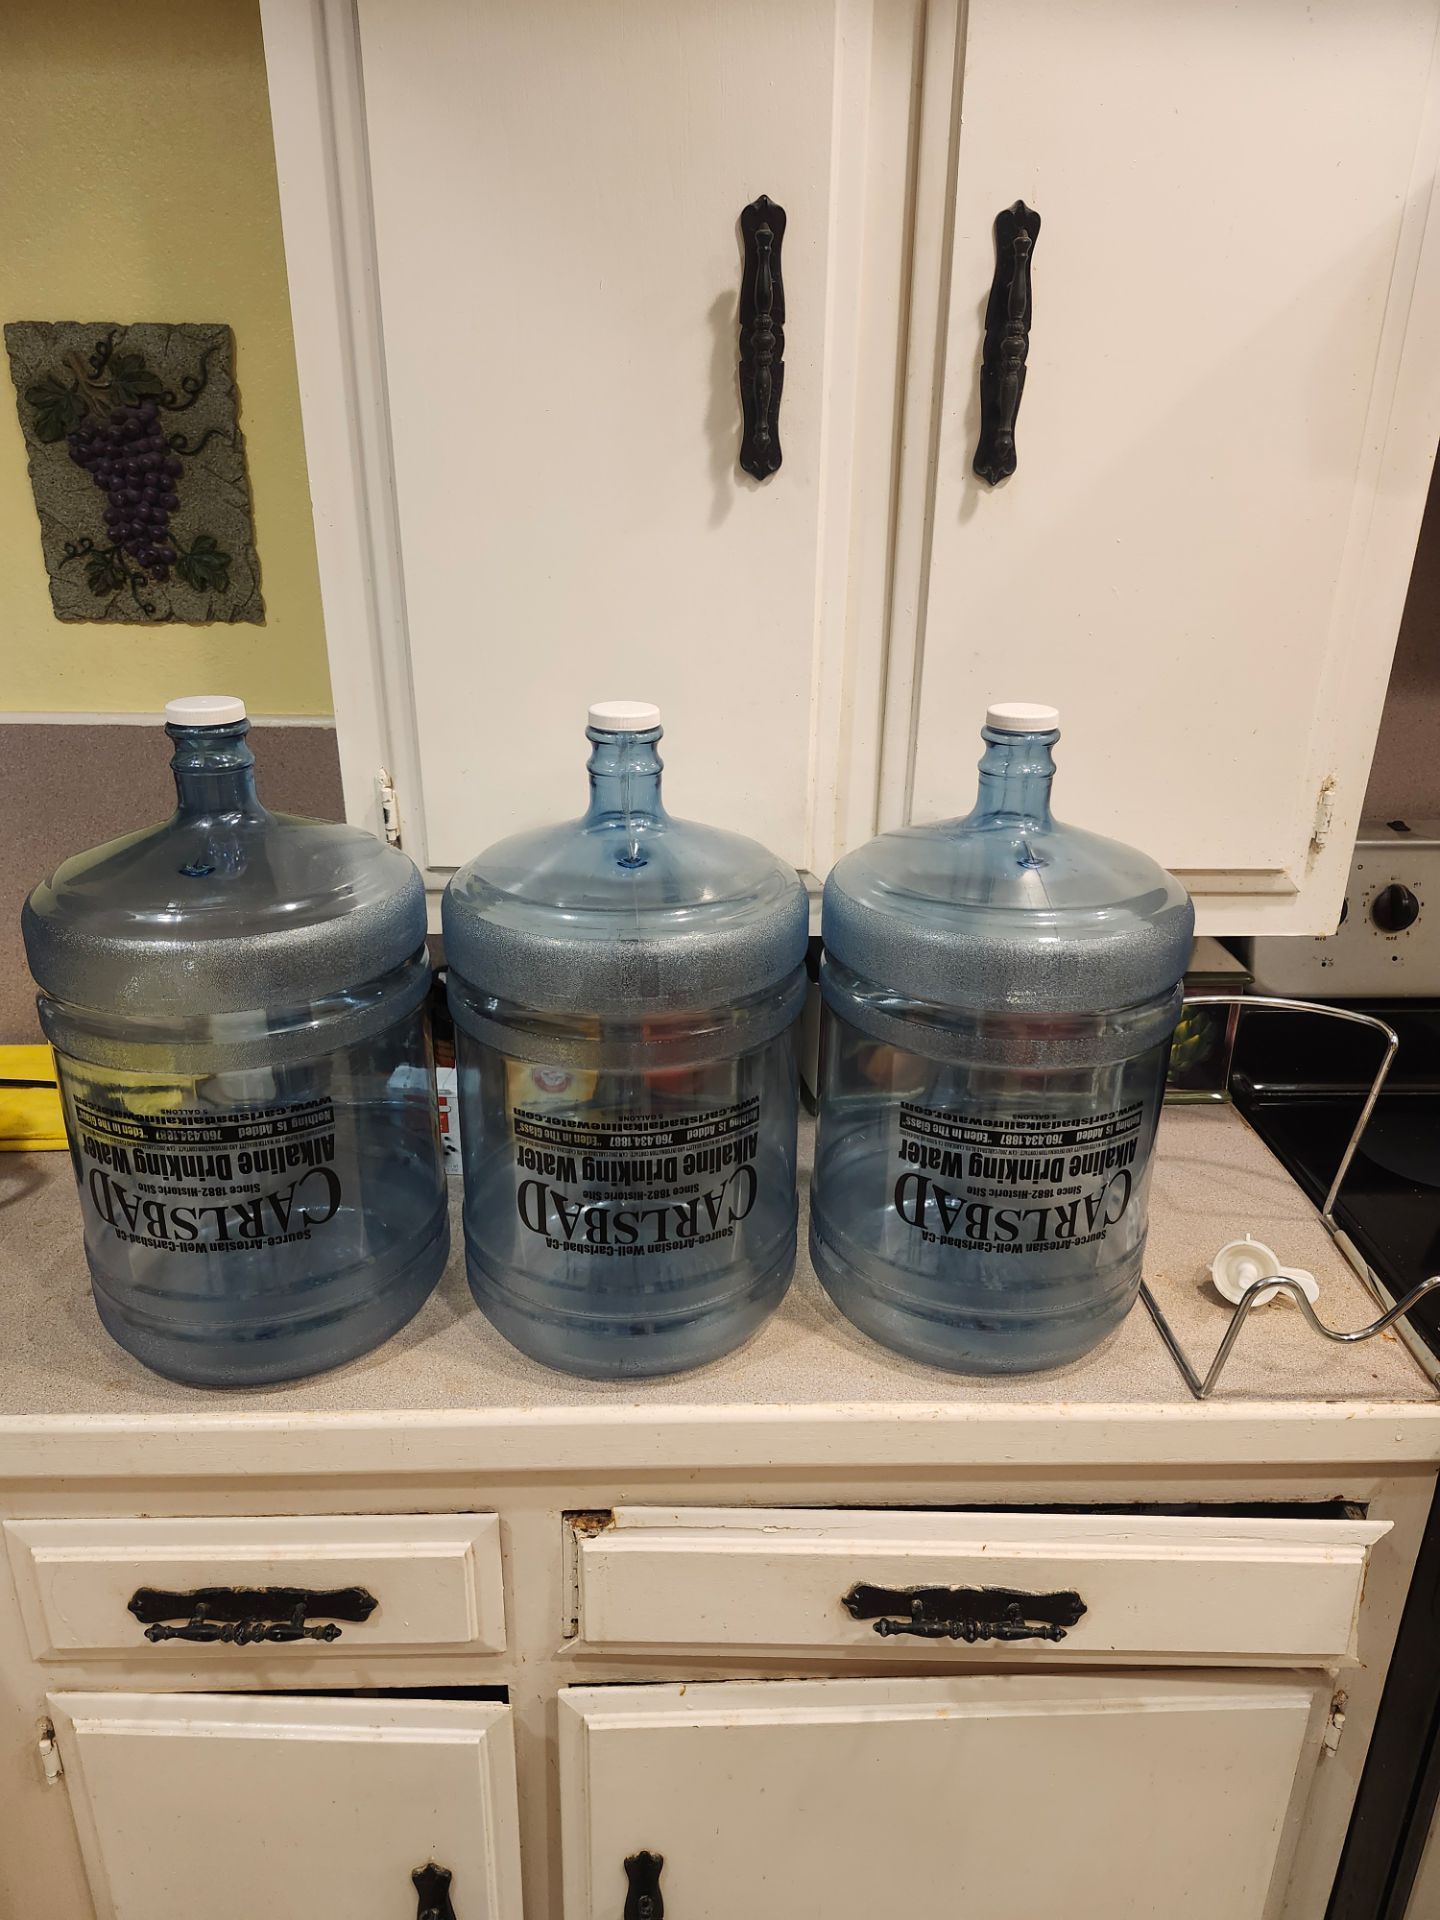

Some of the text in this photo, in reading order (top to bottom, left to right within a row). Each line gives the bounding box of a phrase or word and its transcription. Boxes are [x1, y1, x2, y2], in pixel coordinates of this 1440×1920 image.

[291, 1110, 330, 1128] Nothing
[514, 1096, 760, 1132] www.carlsbadalkalinewater.com
[900, 1101, 1143, 1130] www.carlsbadalkalinewater.com
[95, 1117, 112, 1131] The
[113, 1122, 122, 1134] In
[238, 1123, 273, 1138] Added
[276, 1122, 287, 1133] Is
[686, 1124, 715, 1140] Added
[718, 1121, 726, 1131] Is
[932, 1124, 950, 1138] The
[1106, 1125, 1113, 1135] Is
[156, 1129, 222, 1140] 760.434.1887
[544, 1129, 561, 1142] The
[562, 1132, 572, 1144] In
[610, 1133, 673, 1147] 760.434.1887
[952, 1129, 962, 1140] In
[1000, 1132, 1063, 1144] 760.434.1887
[1076, 1127, 1103, 1142] Added
[83, 1133, 132, 1175] Water
[238, 1134, 335, 1177] Alkaline
[683, 1132, 758, 1178] Alkaline
[898, 1137, 1138, 1184] Alkaline Drinking Water
[135, 1150, 231, 1181] Drinking
[517, 1146, 578, 1184] Water
[582, 1157, 678, 1186] Drinking
[138, 1182, 260, 1196] Since 1882-Historic Site
[583, 1184, 699, 1200] Since 1882-Historic Site
[967, 1185, 1082, 1200] Since 1882-Historic Site
[89, 1167, 342, 1241] CARLSBAD
[518, 1165, 758, 1244] CARLSBAD
[894, 1169, 1132, 1242] CARLSBAD
[115, 1228, 311, 1254] Source-Artesian Well-Carlsbad-CA
[546, 1226, 733, 1256] Source-Artesian Well-Carlsbad-CA
[922, 1230, 1106, 1254] Source-Artesian Well-Carlsbad-CA
